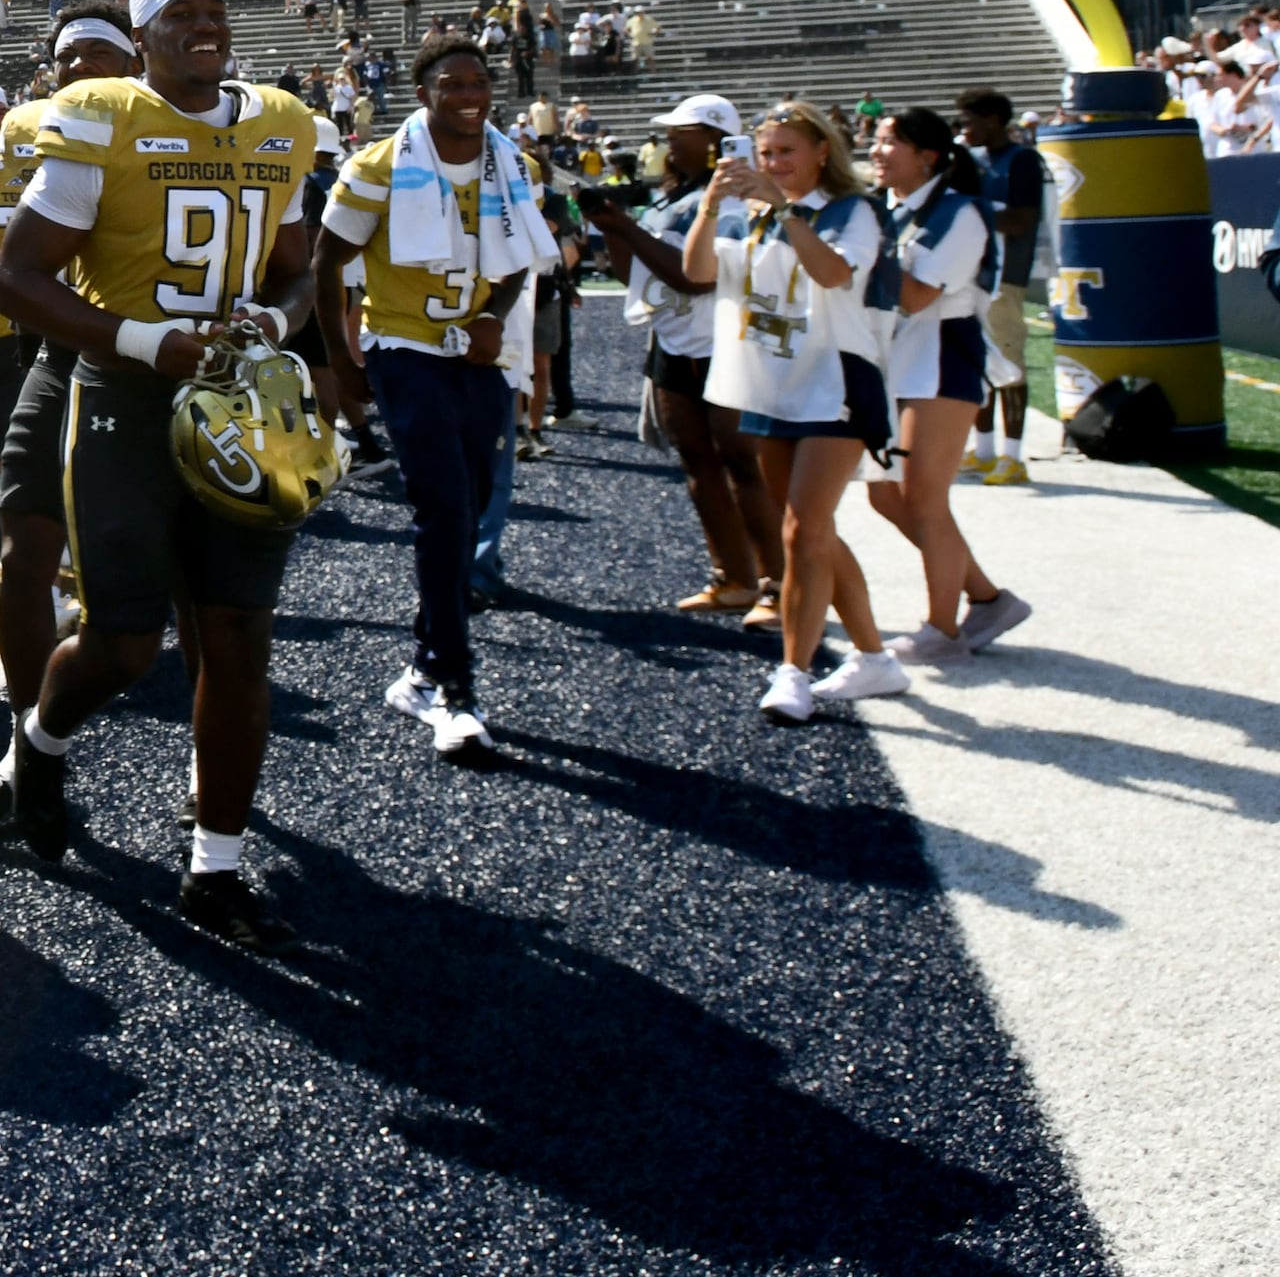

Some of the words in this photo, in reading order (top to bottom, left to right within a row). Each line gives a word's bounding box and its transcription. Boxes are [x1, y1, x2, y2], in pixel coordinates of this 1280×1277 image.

[260, 138, 292, 151] ACC
[148, 162, 236, 181] GEORGIA
[242, 162, 290, 183] TECH
[153, 186, 270, 320] 91
